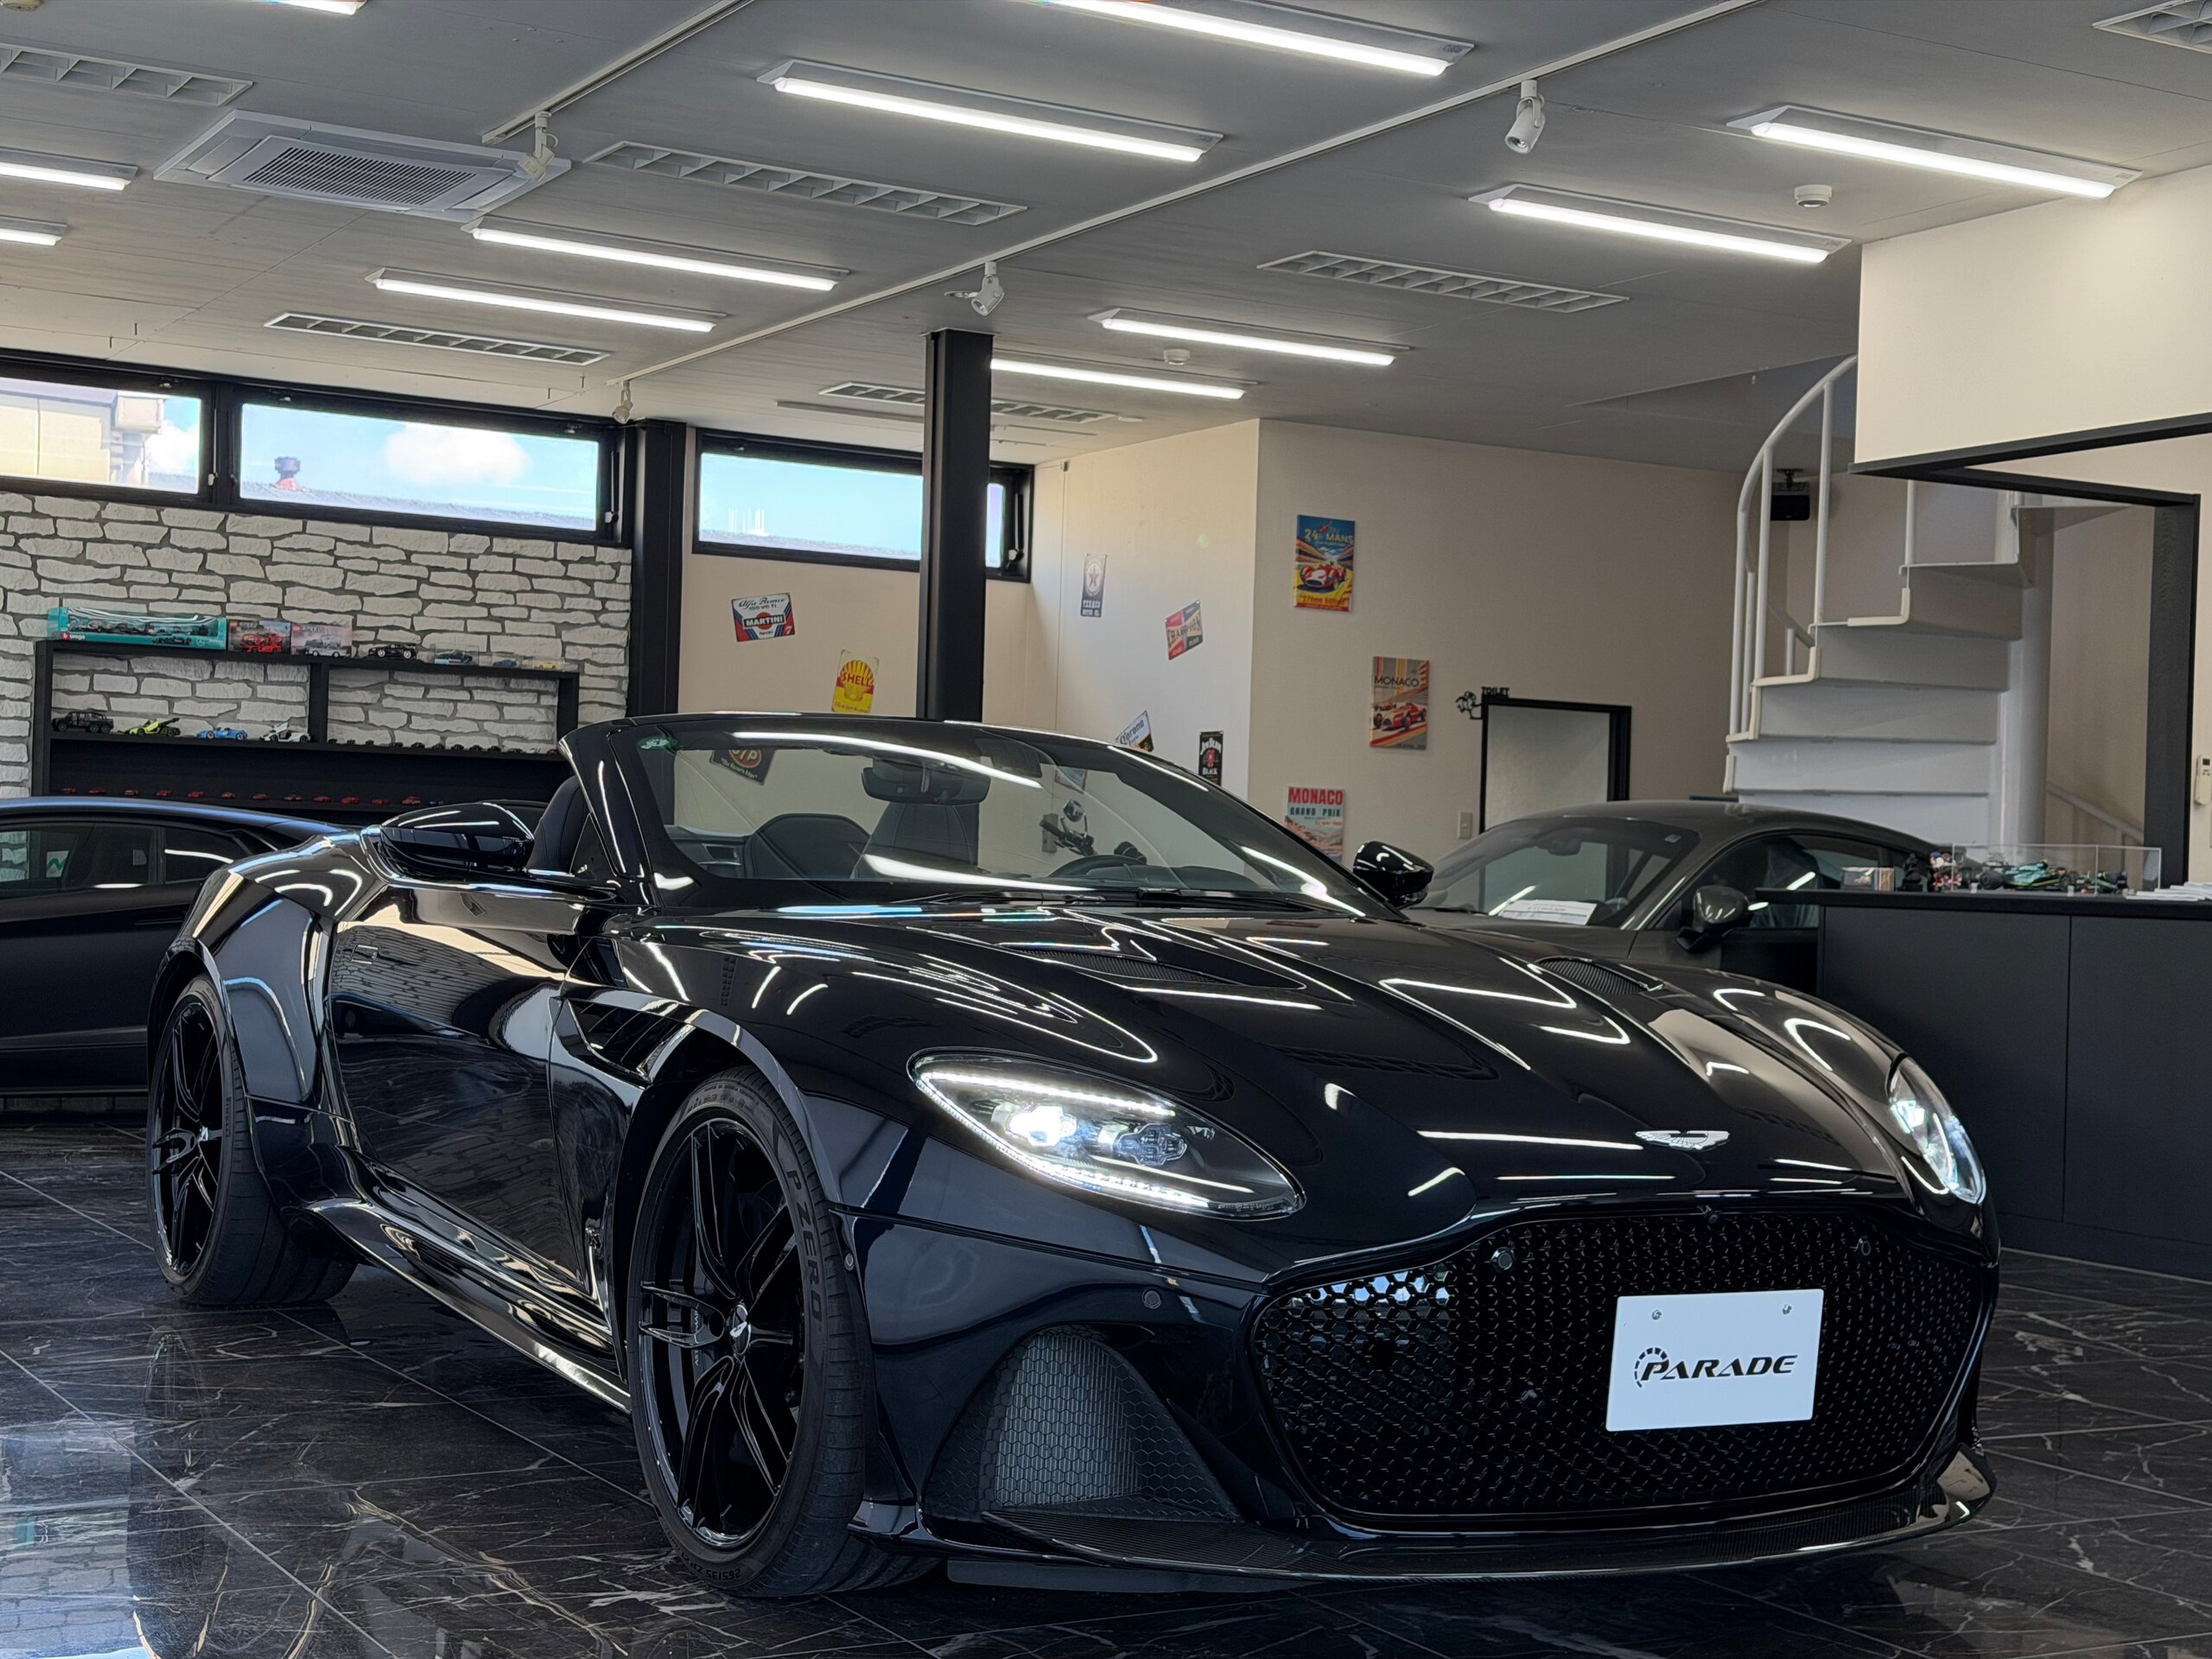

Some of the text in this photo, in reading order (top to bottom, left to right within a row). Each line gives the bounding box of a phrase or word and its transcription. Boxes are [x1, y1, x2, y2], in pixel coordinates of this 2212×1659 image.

[739, 600, 756, 609] Alfa
[746, 615, 784, 626] MARTINI
[785, 626, 792, 634] 7
[842, 672, 872, 687] SHELL
[1374, 676, 1420, 688] MONACO
[1481, 687, 1510, 697] TOILET
[1120, 720, 1145, 745] Corona
[1202, 766, 1218, 775] BLACK
[1288, 787, 1344, 805] MONACO
[1290, 807, 1341, 817] GRAND PRIX
[787, 1170, 823, 1323] P ZERO
[1638, 1351, 1799, 1383] PARADE
